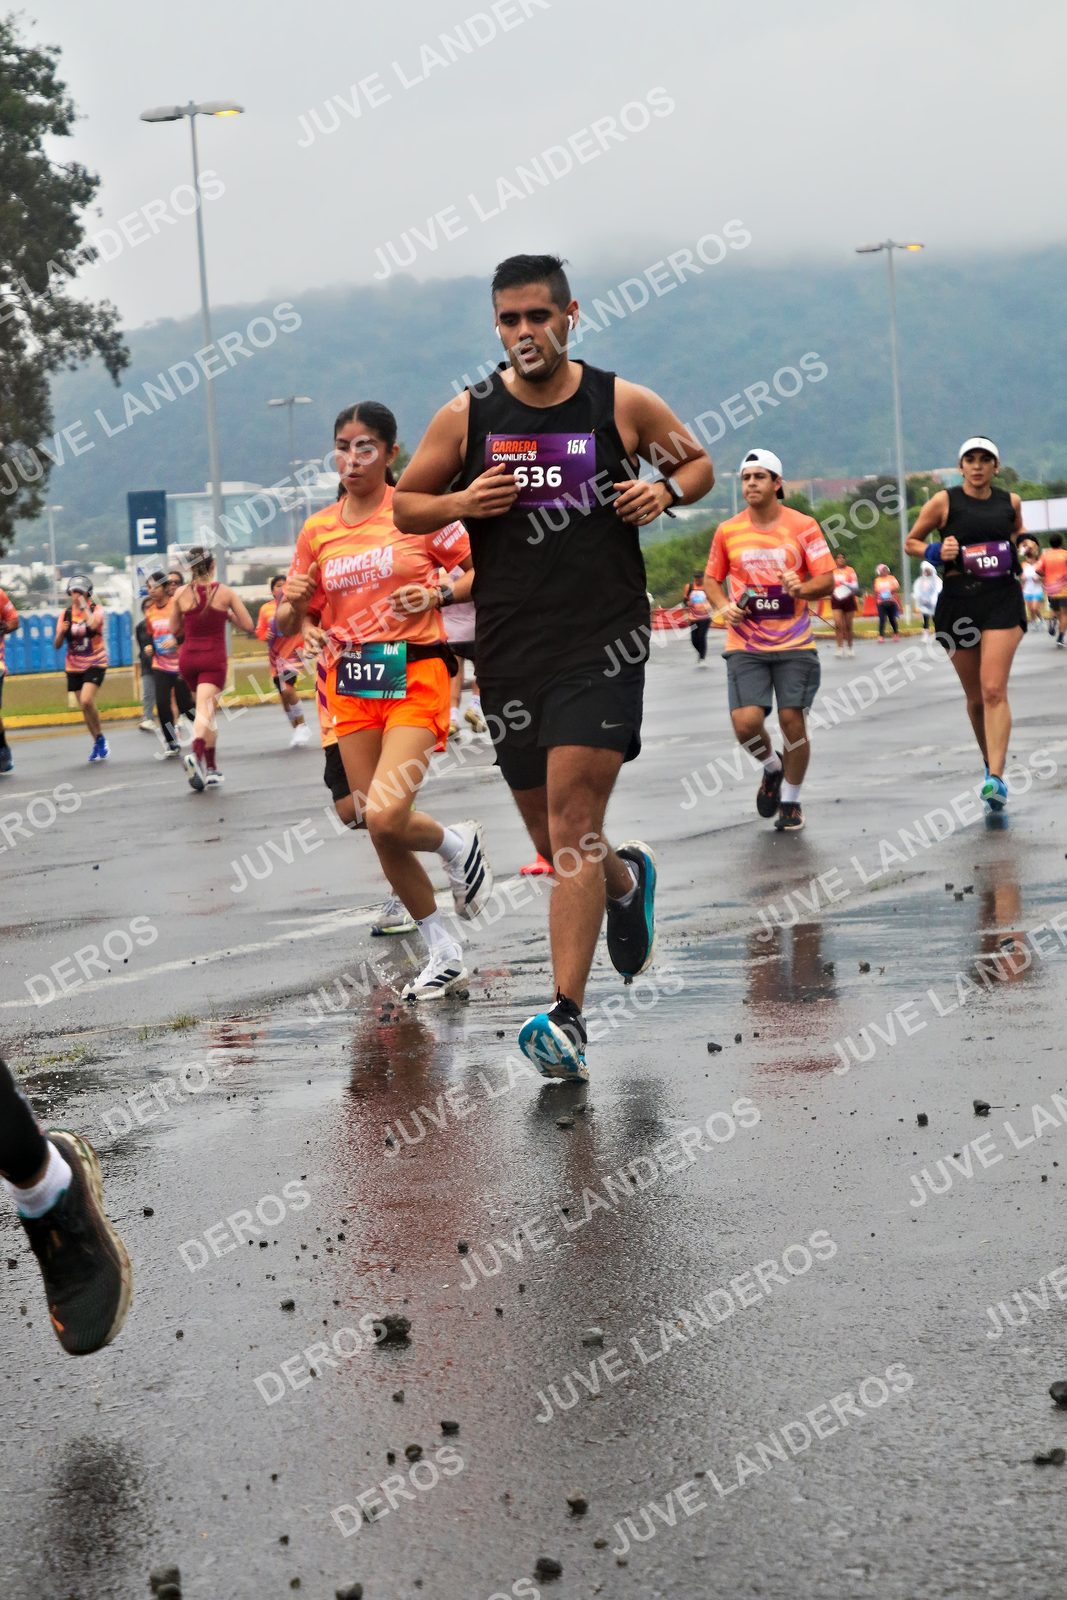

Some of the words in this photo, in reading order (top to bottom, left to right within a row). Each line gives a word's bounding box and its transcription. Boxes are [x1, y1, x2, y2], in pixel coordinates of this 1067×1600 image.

[492, 440, 537, 453] CARRERA
[513, 466, 562, 488] 636
[136, 518, 158, 546] E
[325, 545, 393, 578] CARRERA
[976, 555, 998, 568] 190
[756, 598, 780, 610] 646
[345, 662, 385, 681] 1317
